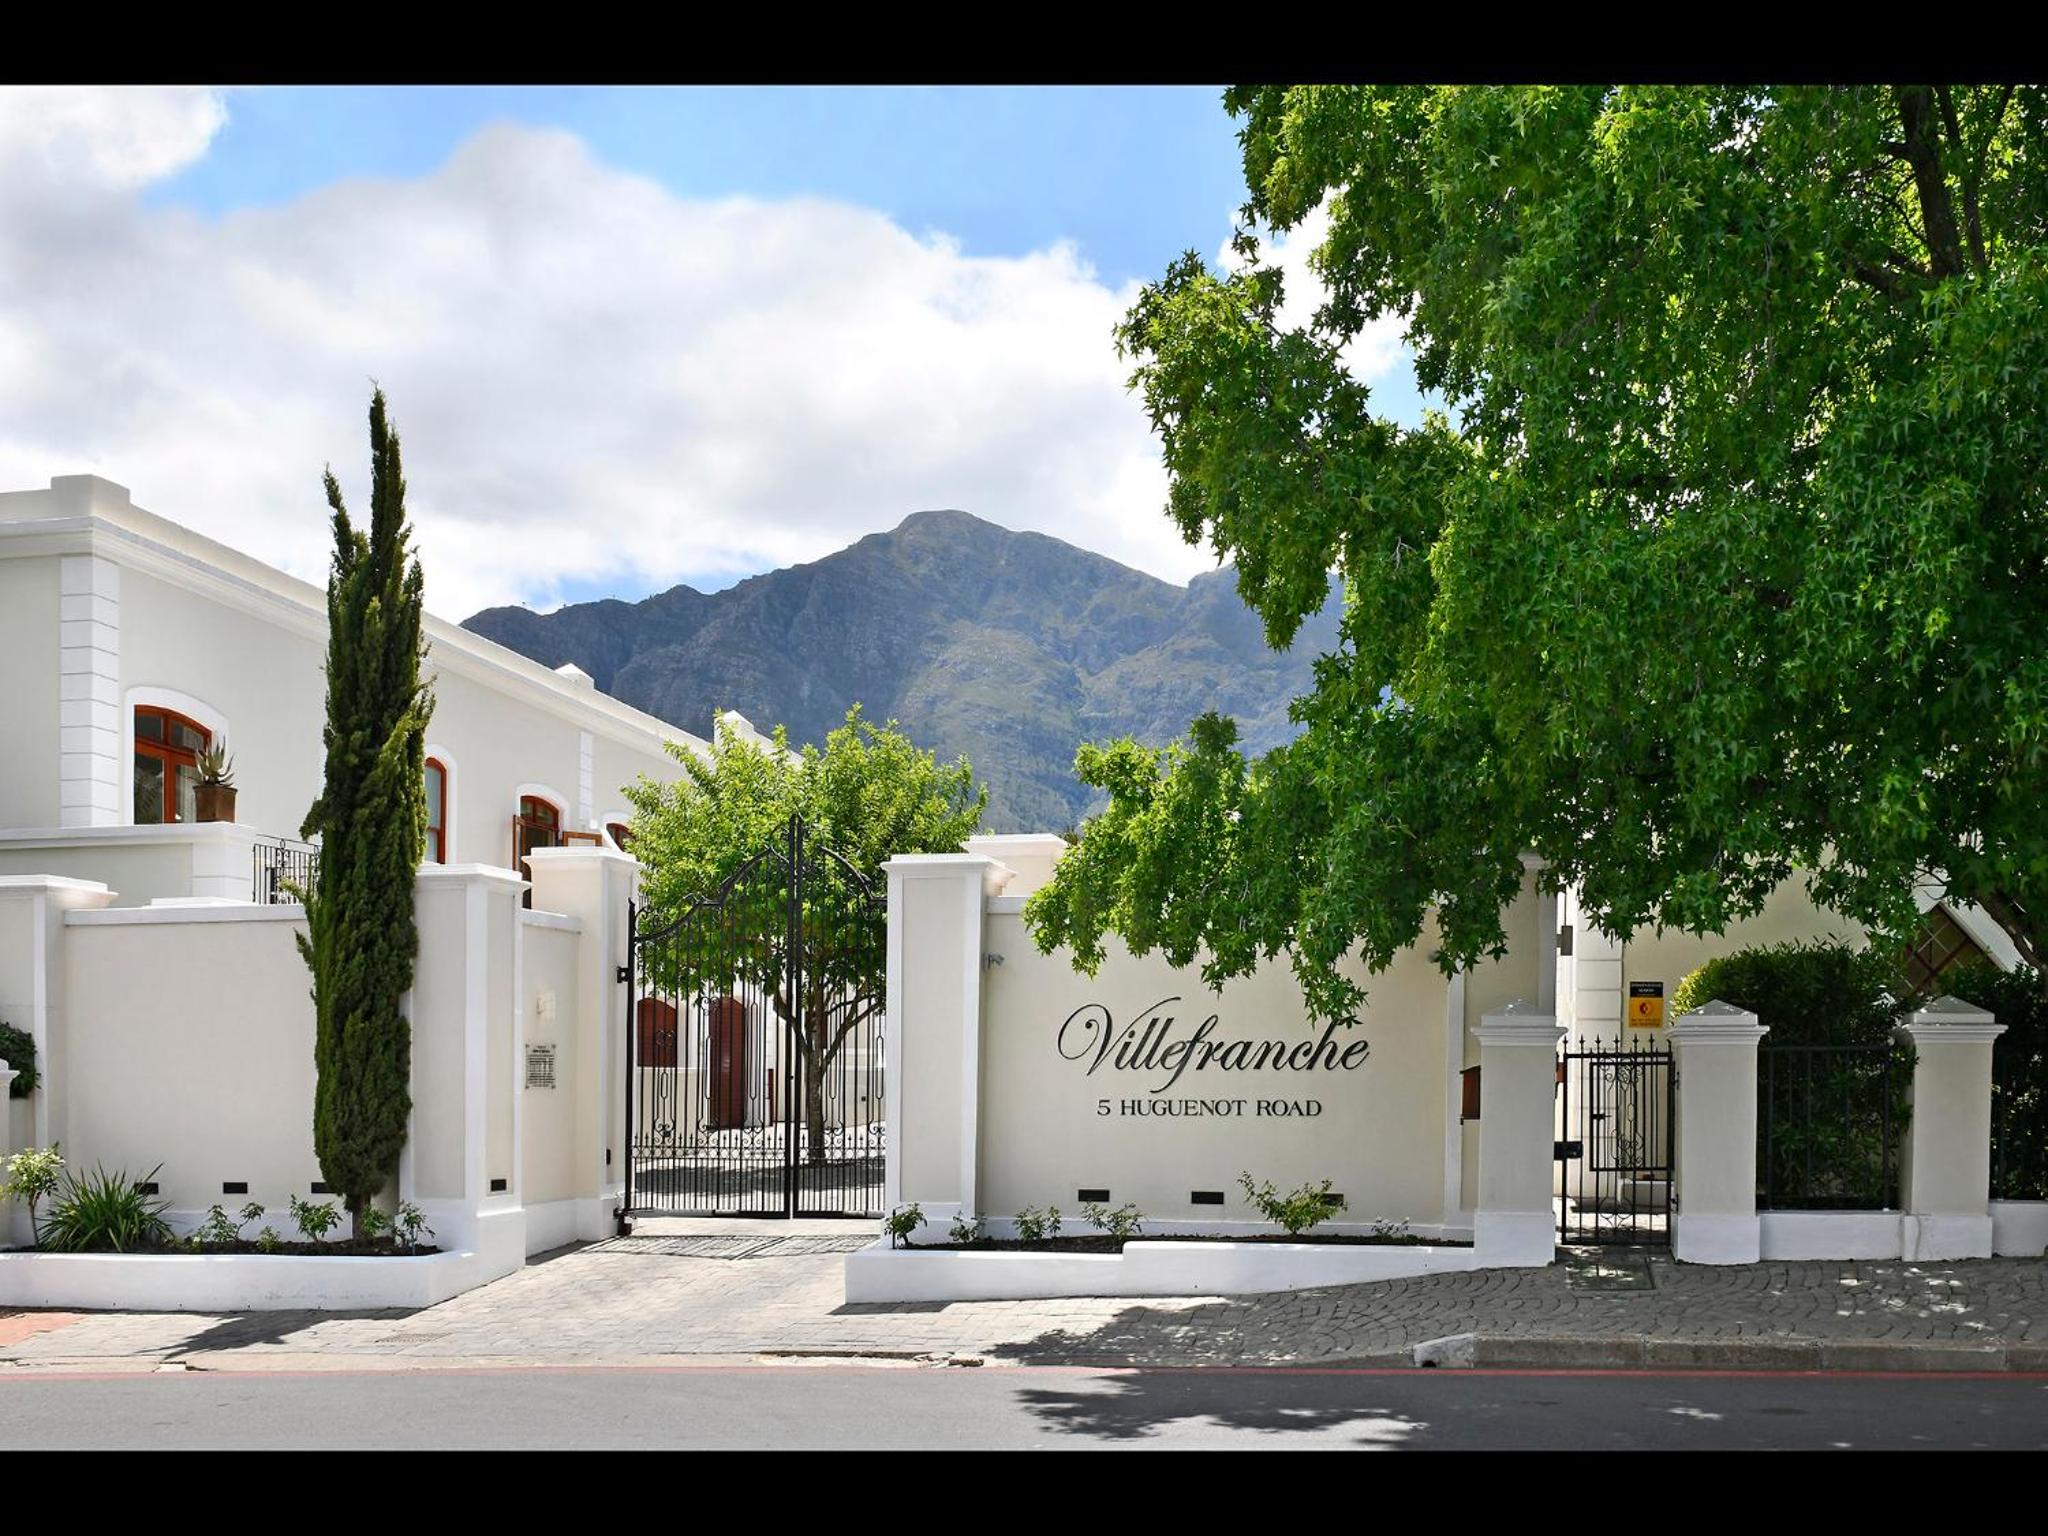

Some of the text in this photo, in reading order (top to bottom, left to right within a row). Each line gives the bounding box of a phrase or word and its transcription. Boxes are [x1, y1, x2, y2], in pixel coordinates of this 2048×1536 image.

[1057, 996, 1370, 1094] Villefranche
[1097, 1099, 1323, 1117] 5 HUGUENOT ROAD
